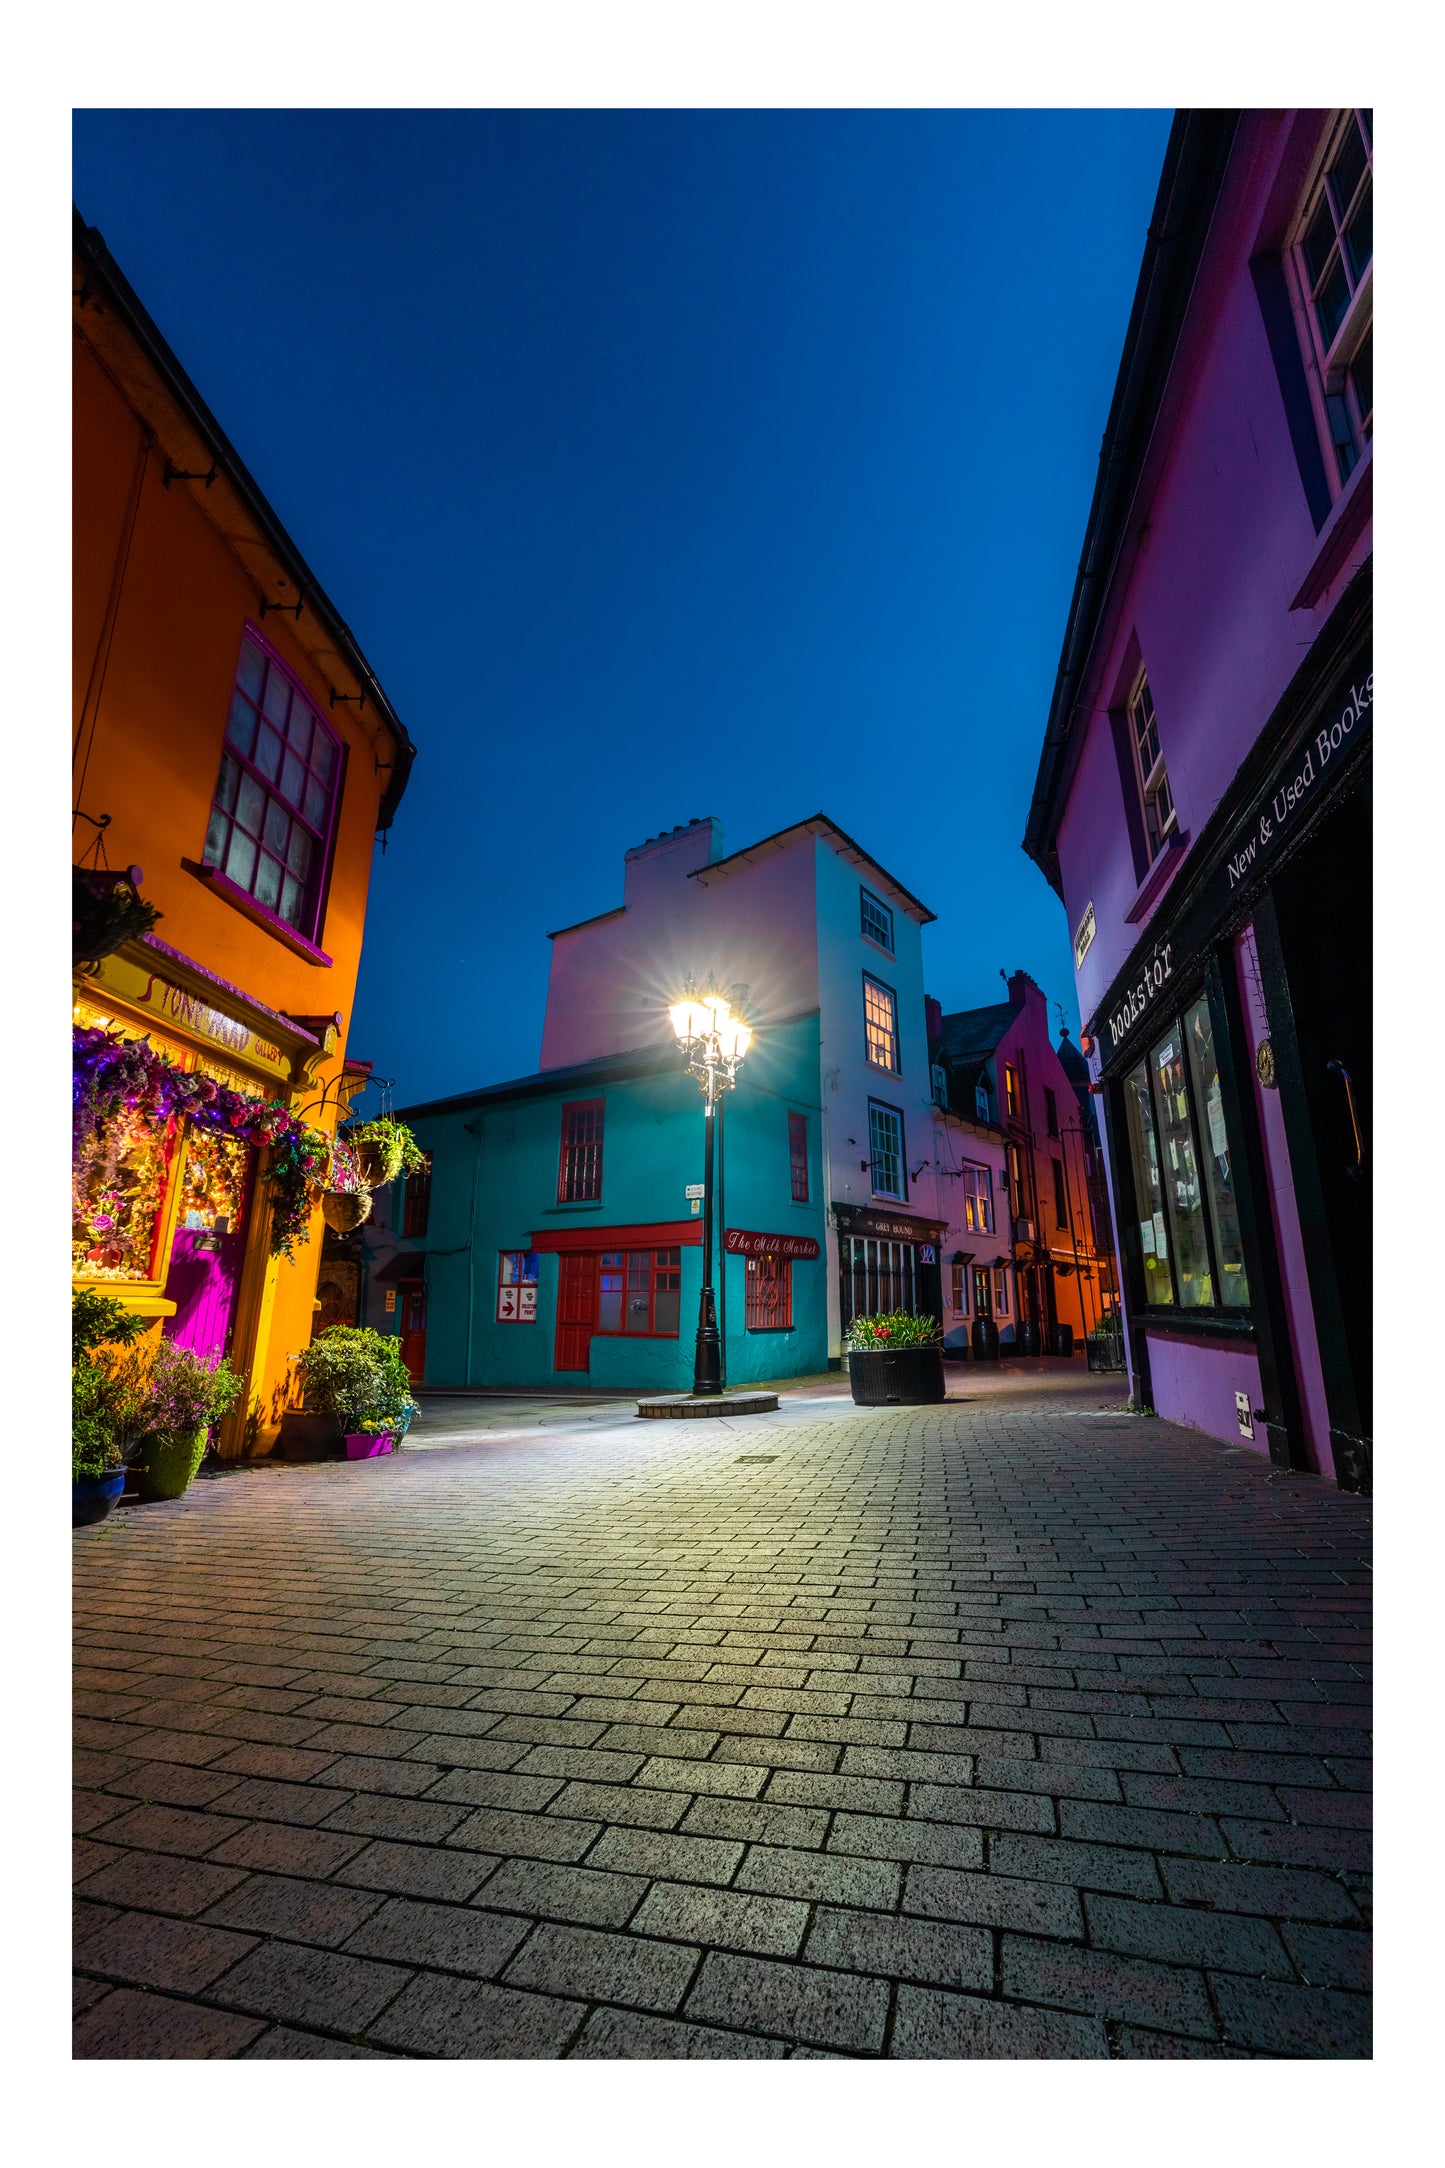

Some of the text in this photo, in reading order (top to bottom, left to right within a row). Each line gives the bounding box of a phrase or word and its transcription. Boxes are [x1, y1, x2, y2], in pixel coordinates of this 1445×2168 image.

[1227, 672, 1374, 889] New & Used Books
[254, 1039, 285, 1067] GALLERY
[875, 1221, 891, 1233] GREY
[727, 1231, 817, 1256] The Milk Market
